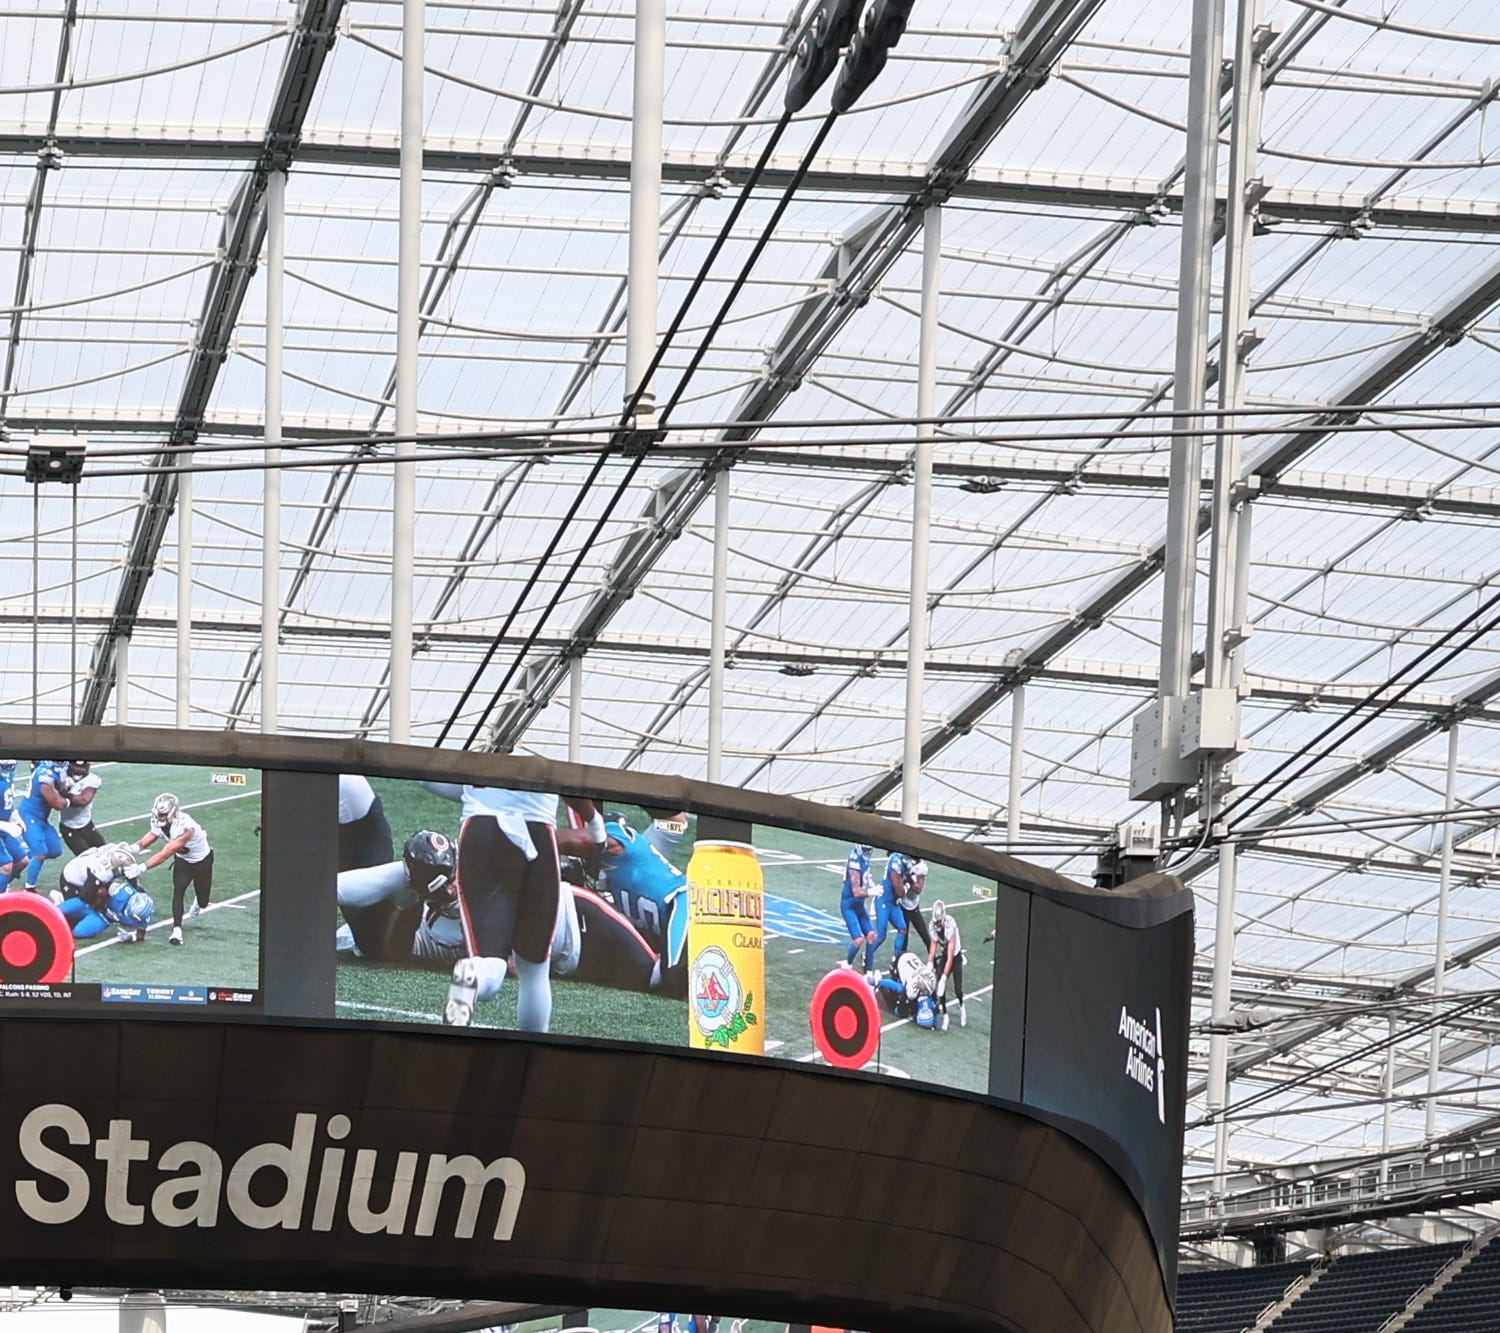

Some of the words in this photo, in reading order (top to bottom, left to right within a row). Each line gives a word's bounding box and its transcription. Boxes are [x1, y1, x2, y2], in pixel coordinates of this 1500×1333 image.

[211, 774, 228, 783] FOX
[229, 775, 245, 784] NFL
[1118, 1005, 1156, 1059] American
[1125, 1046, 1154, 1093] Airlines
[15, 1102, 527, 1242] Stadium
